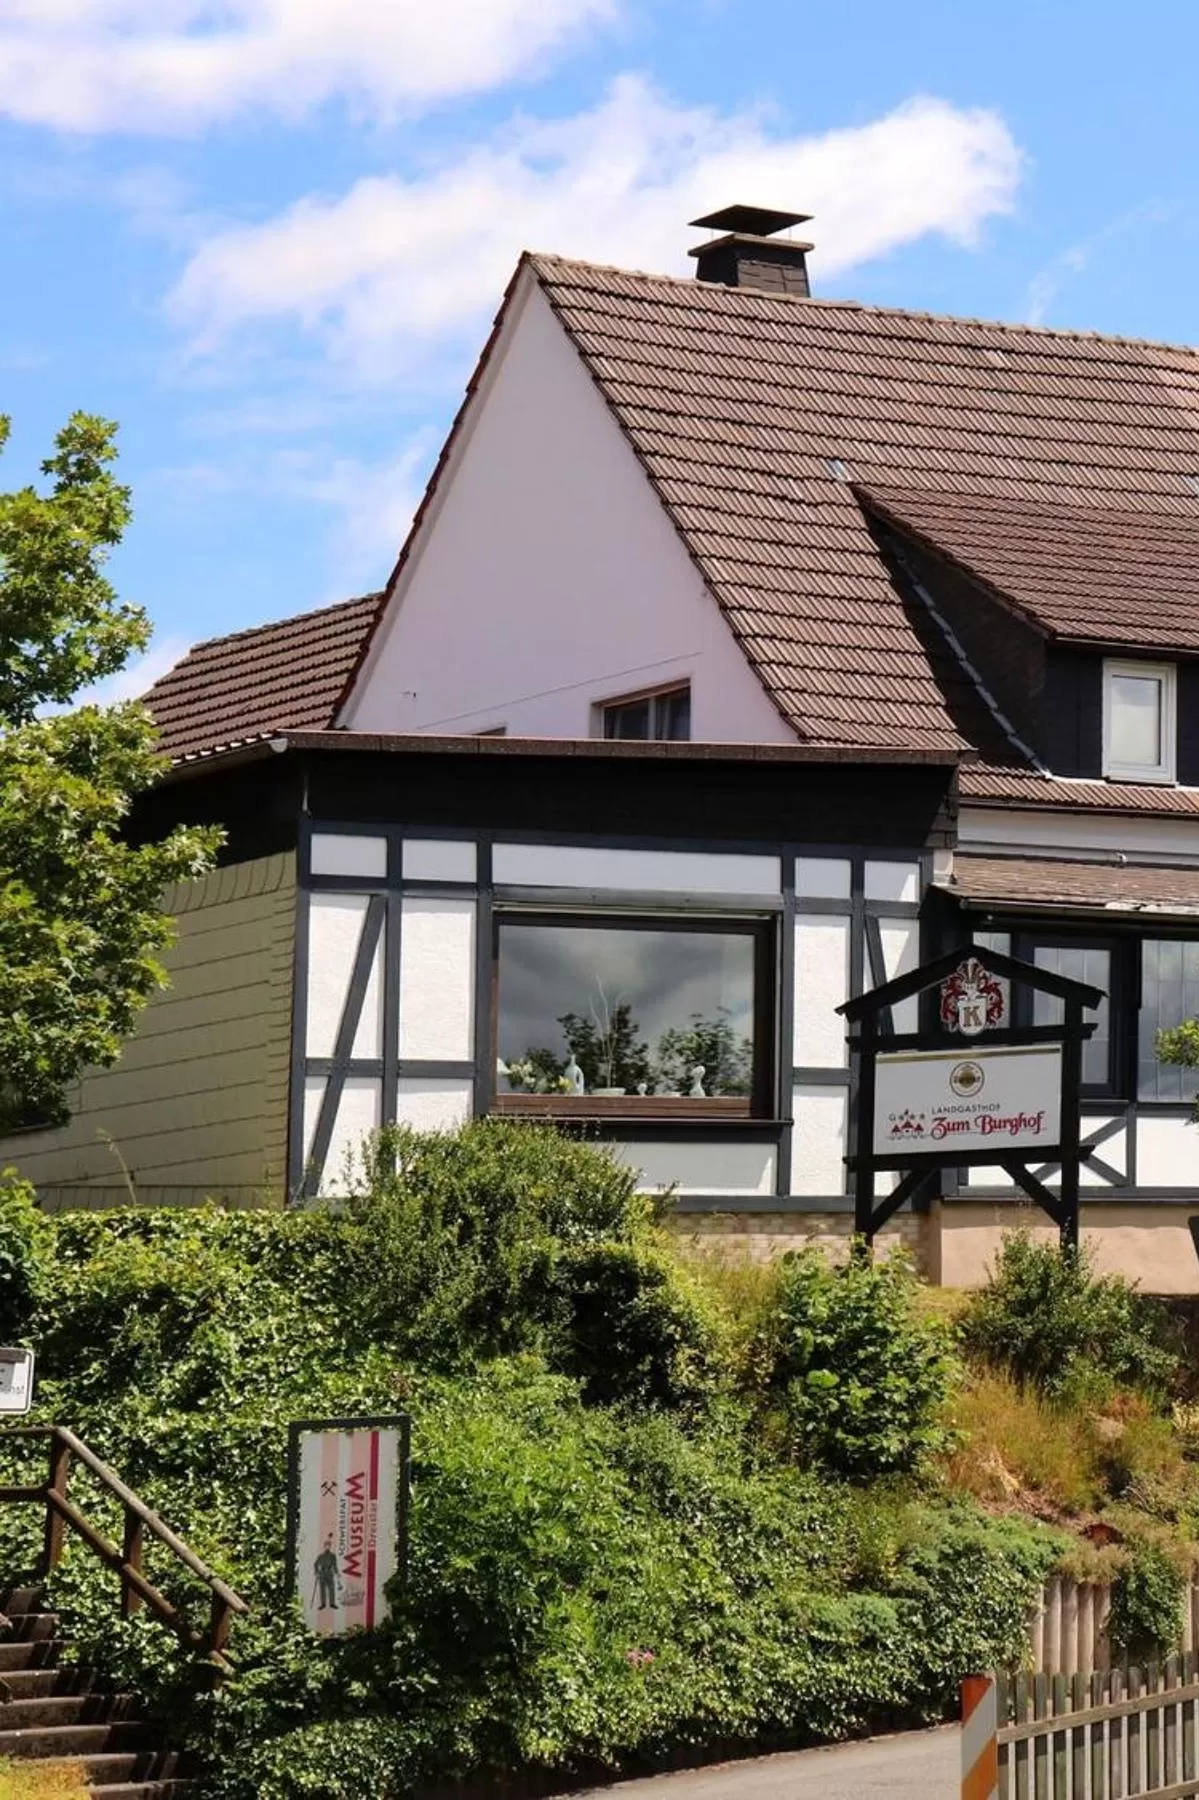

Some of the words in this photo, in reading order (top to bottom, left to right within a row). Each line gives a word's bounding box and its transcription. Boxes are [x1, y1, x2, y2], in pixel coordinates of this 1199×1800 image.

[962, 1005, 982, 1027] K
[931, 1103, 1001, 1115] LANDGASTHOF
[930, 1116, 971, 1140] Zum
[974, 1110, 1046, 1136] Burghof
